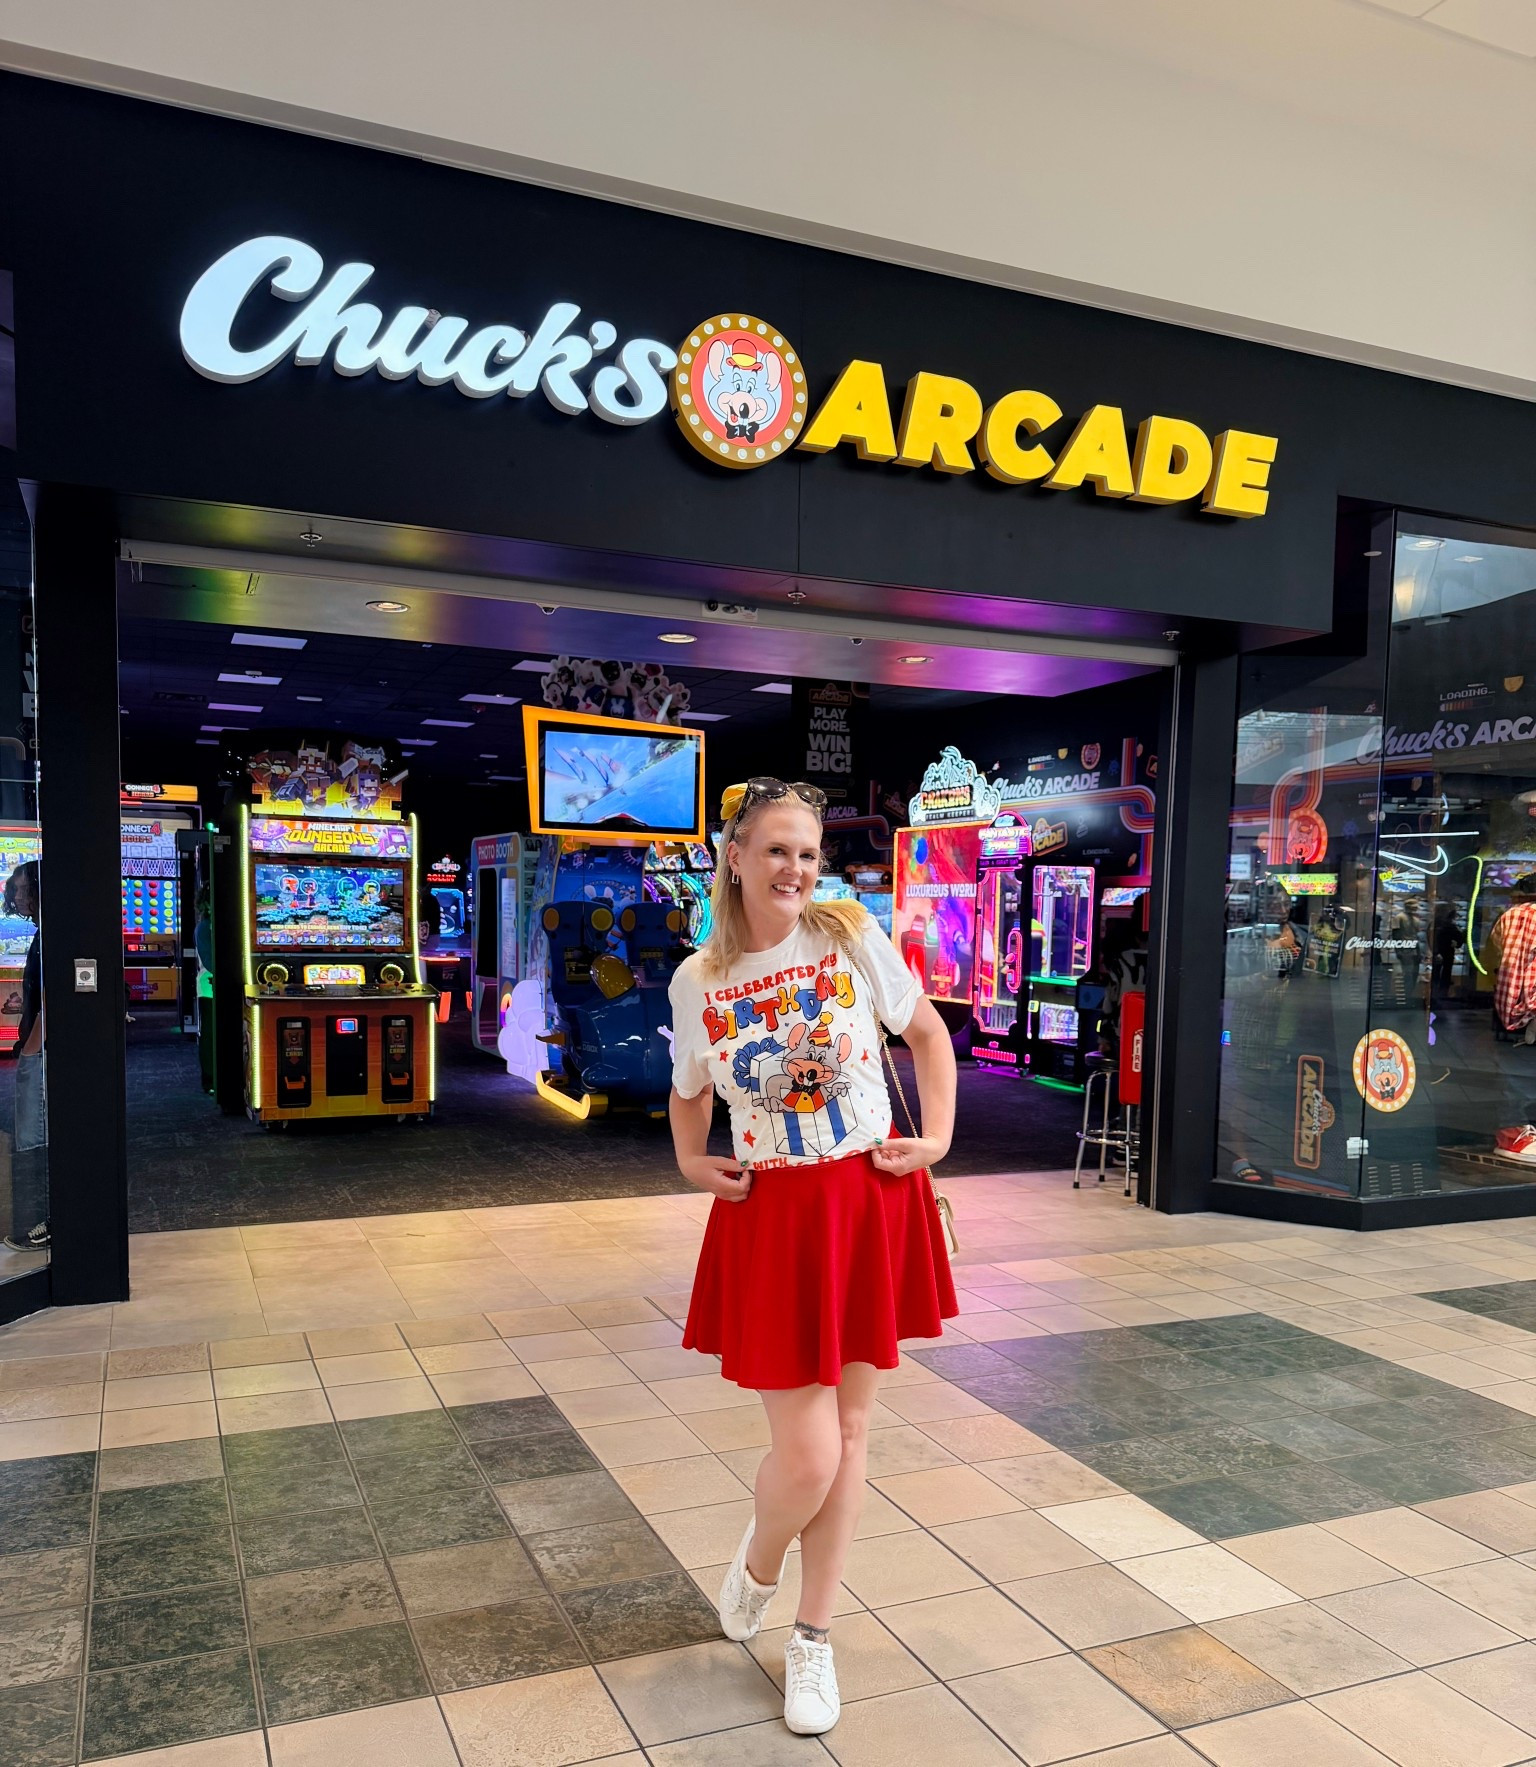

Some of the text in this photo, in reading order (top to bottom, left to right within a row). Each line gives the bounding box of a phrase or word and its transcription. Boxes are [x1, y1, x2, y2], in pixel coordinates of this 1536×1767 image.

[180, 236, 1278, 519] Chuck's ARCADE
[814, 707, 847, 720] PLAY
[810, 719, 850, 733] MORE.
[808, 733, 851, 753] WIN
[1356, 716, 1536, 766] Chuck's ARC
[806, 751, 852, 774] BIG!
[992, 772, 1100, 800] Chuck's ARCADE
[285, 829, 379, 846] DUNGEONS
[313, 844, 351, 853] ARCADE
[478, 842, 514, 860] PHOTO BOOTH
[906, 883, 949, 898] LUXURIOUS
[1383, 939, 1418, 949] ARCADE
[704, 953, 837, 1005] I CELEBRATED MY
[702, 971, 855, 1046] BIRTHDAY
[1300, 1062, 1317, 1162] ARCADE
[753, 1157, 789, 1170] WITH
